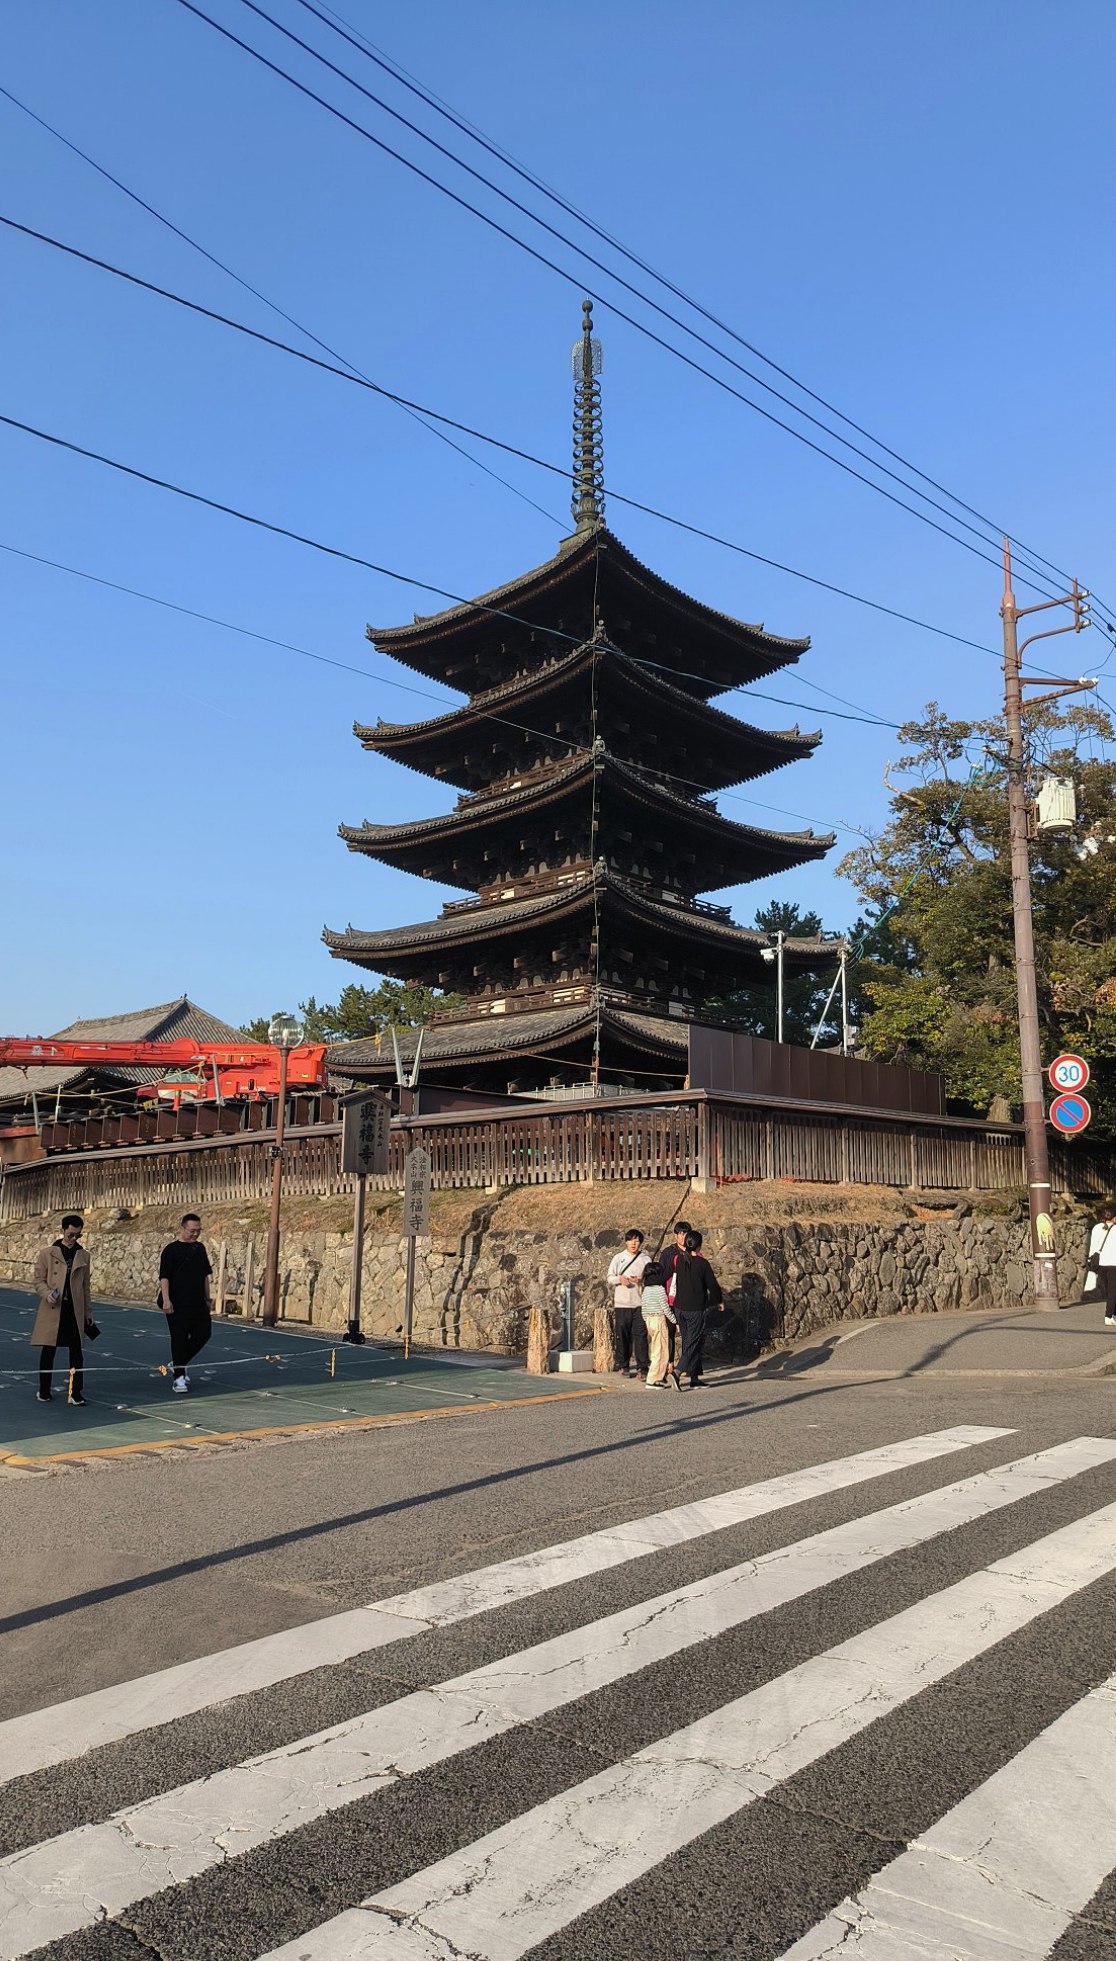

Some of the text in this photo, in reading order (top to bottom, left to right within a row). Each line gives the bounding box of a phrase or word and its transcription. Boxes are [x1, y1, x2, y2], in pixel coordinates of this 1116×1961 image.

[1058, 1065, 1080, 1082] 30
[359, 1101, 377, 1165] 興福寺
[409, 1180, 424, 1231] 興福寺
